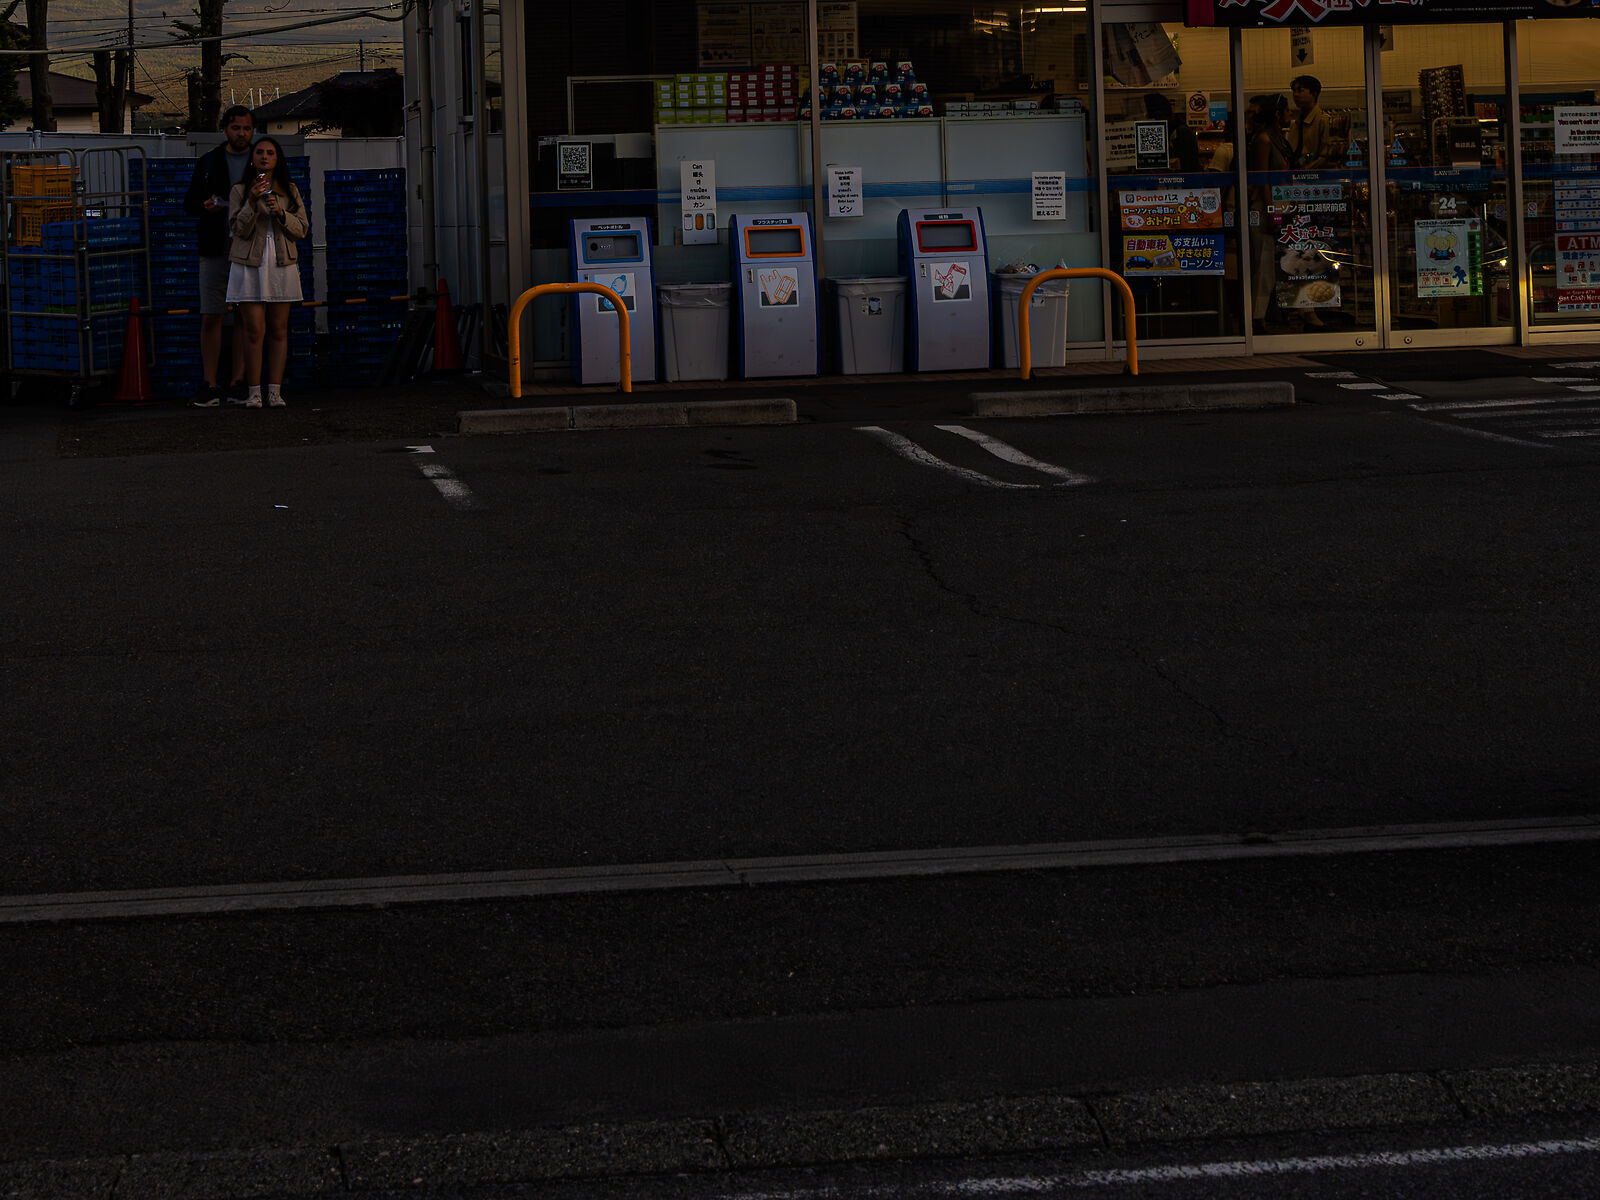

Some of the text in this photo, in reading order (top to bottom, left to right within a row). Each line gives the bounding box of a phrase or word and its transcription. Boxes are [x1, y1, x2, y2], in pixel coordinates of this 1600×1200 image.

[839, 205, 853, 213] ビン
[1439, 197, 1457, 210] 24
[1126, 239, 1168, 251] 自動車税
[1567, 237, 1600, 250] ATM
